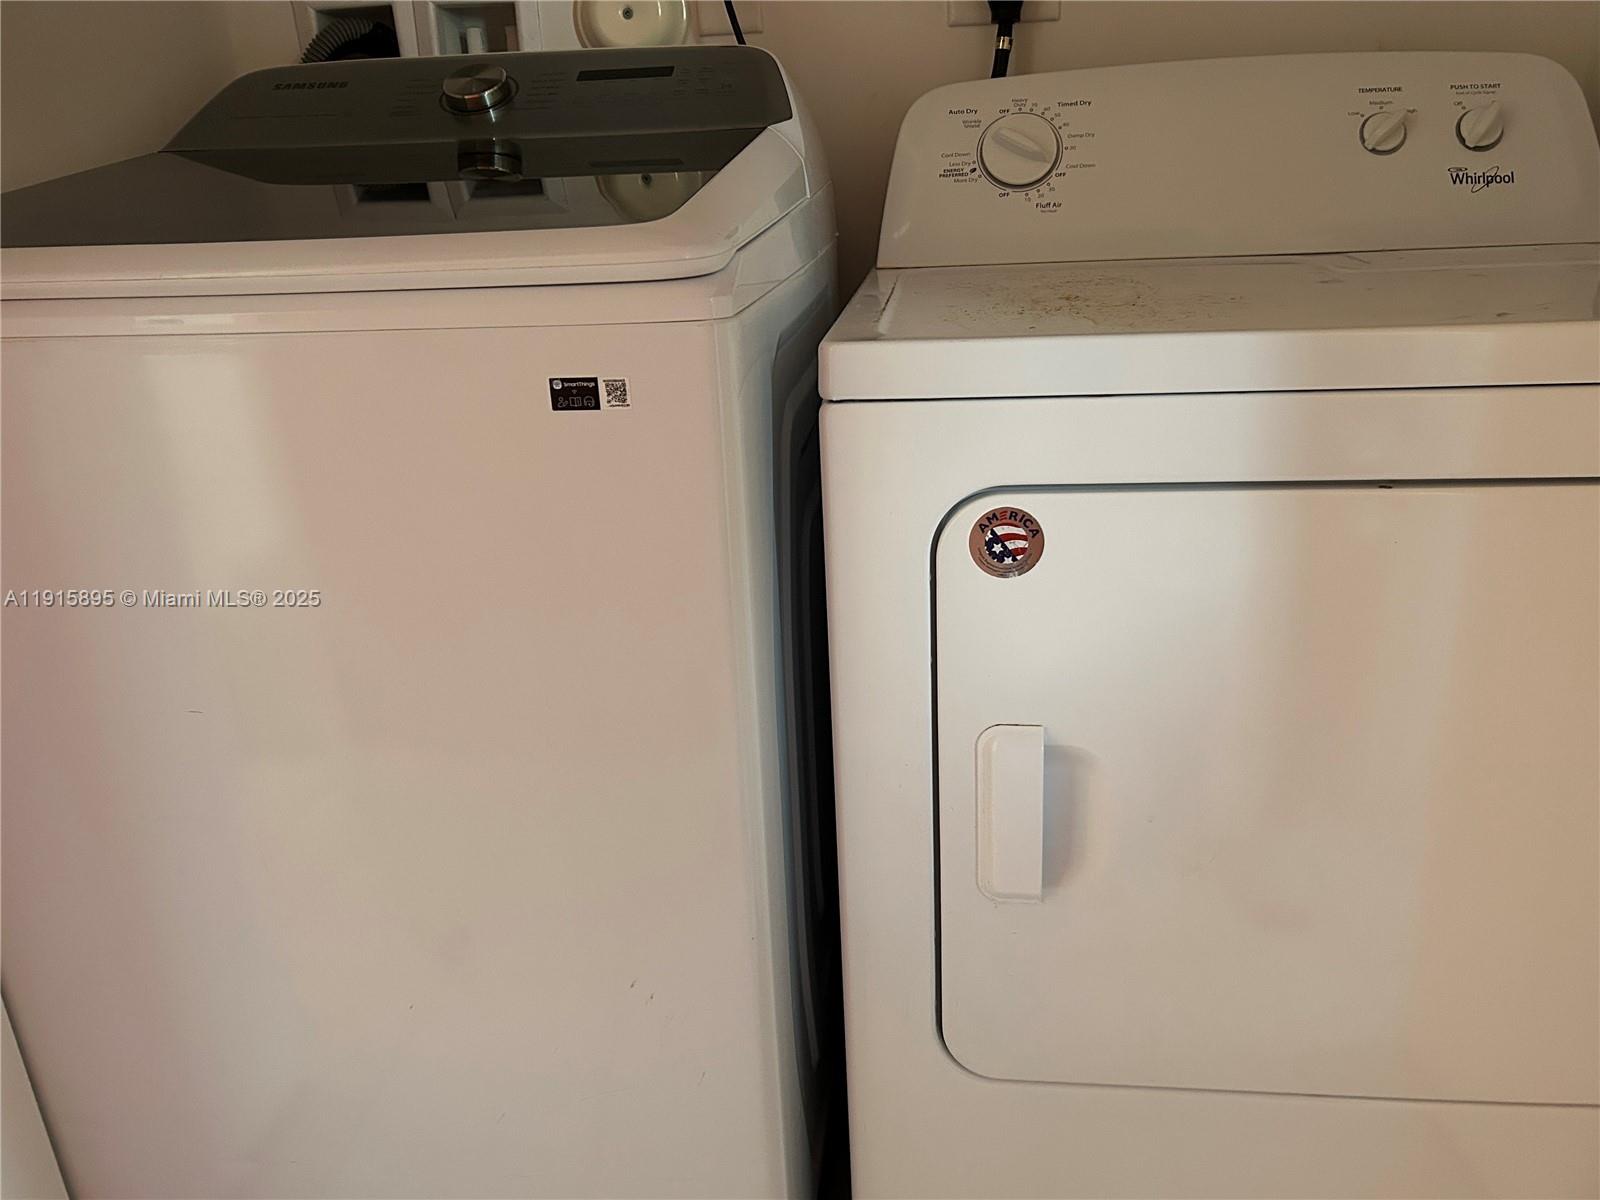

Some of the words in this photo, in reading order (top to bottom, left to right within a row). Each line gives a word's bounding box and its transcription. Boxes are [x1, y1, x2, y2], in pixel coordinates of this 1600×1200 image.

[272, 80, 348, 91] SAMSUNG
[1358, 86, 1403, 94] TEMPERATURE
[1057, 100, 1078, 108] Timed
[1079, 99, 1092, 107] Dry
[1450, 171, 1515, 188] Whirlpool
[979, 510, 1040, 538] AMERICA
